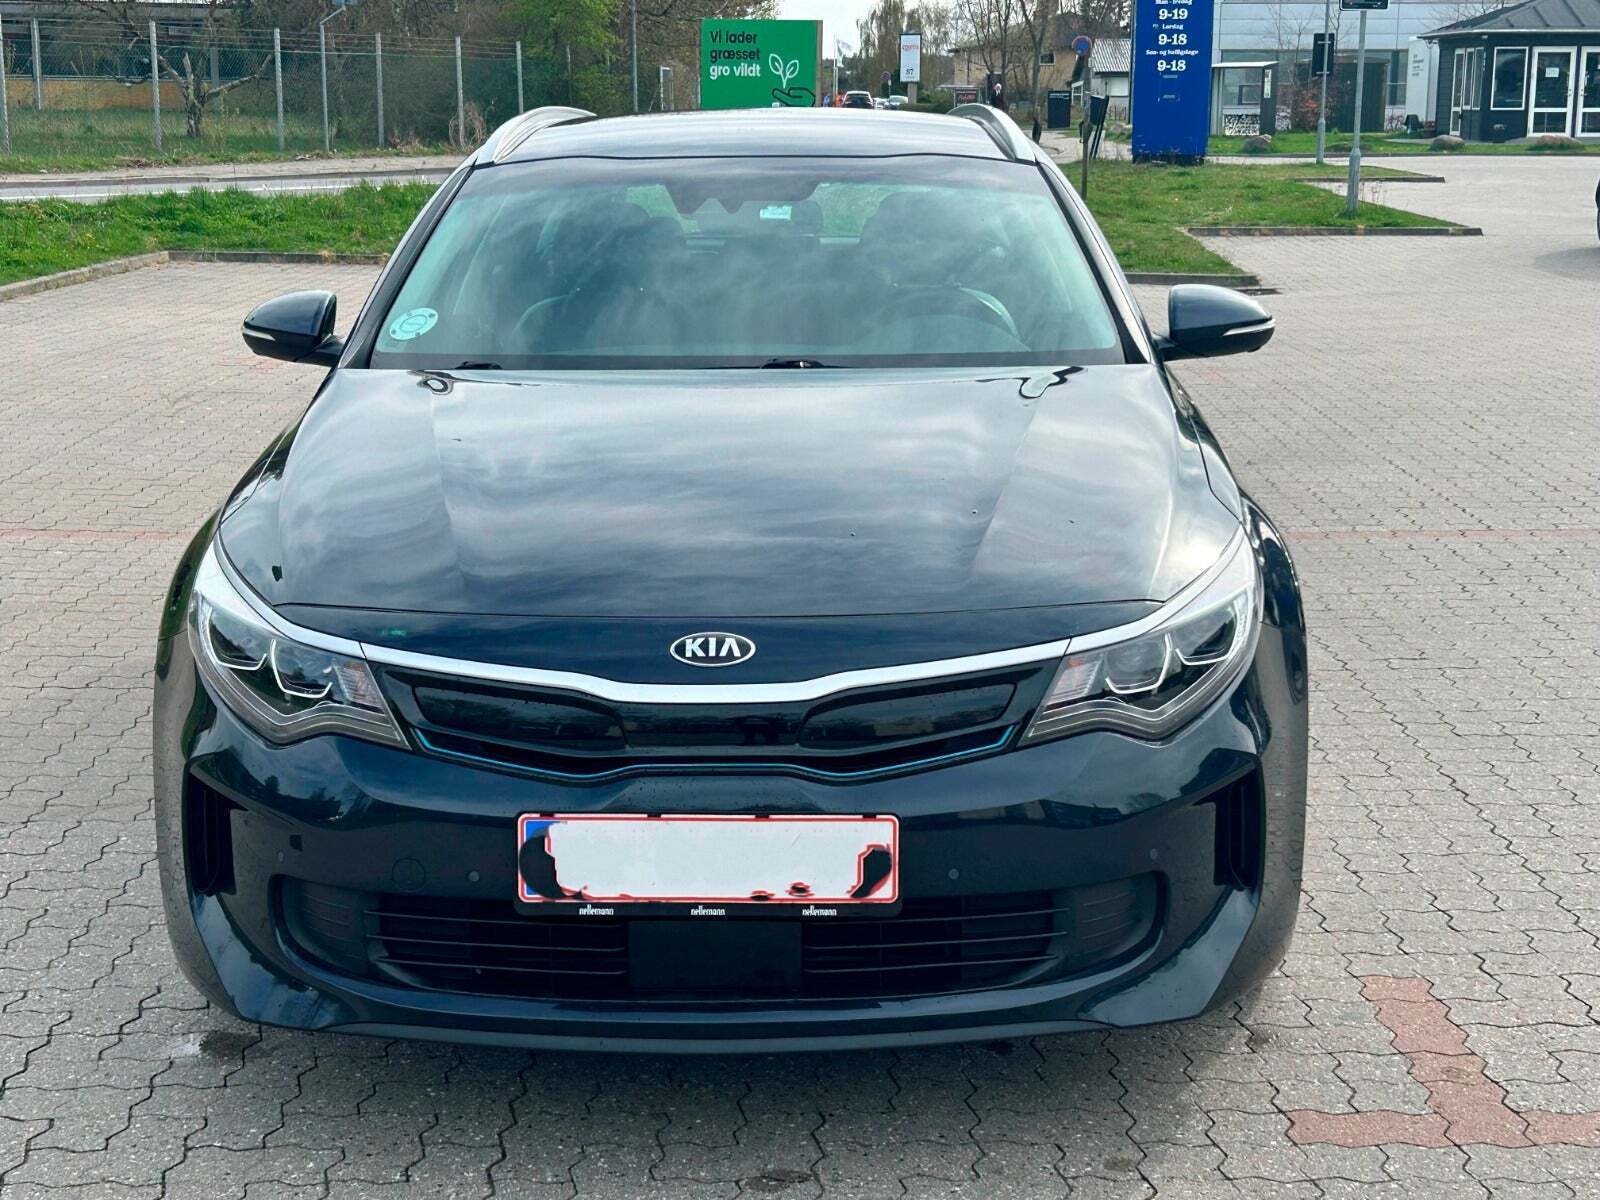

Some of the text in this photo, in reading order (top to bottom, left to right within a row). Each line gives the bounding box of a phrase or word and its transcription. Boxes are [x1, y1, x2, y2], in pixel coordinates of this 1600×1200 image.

[1159, 8, 1188, 20] 9-19
[710, 30, 757, 43] Vi lader
[1158, 33, 1187, 45] 9-18
[710, 48, 760, 63] græsset
[710, 63, 761, 80] gro vildt
[1157, 60, 1186, 71] 9-18
[685, 637, 741, 657] KIA
[579, 904, 614, 915] nellemann
[690, 905, 725, 915] nellemann
[802, 905, 837, 916] nellemann
